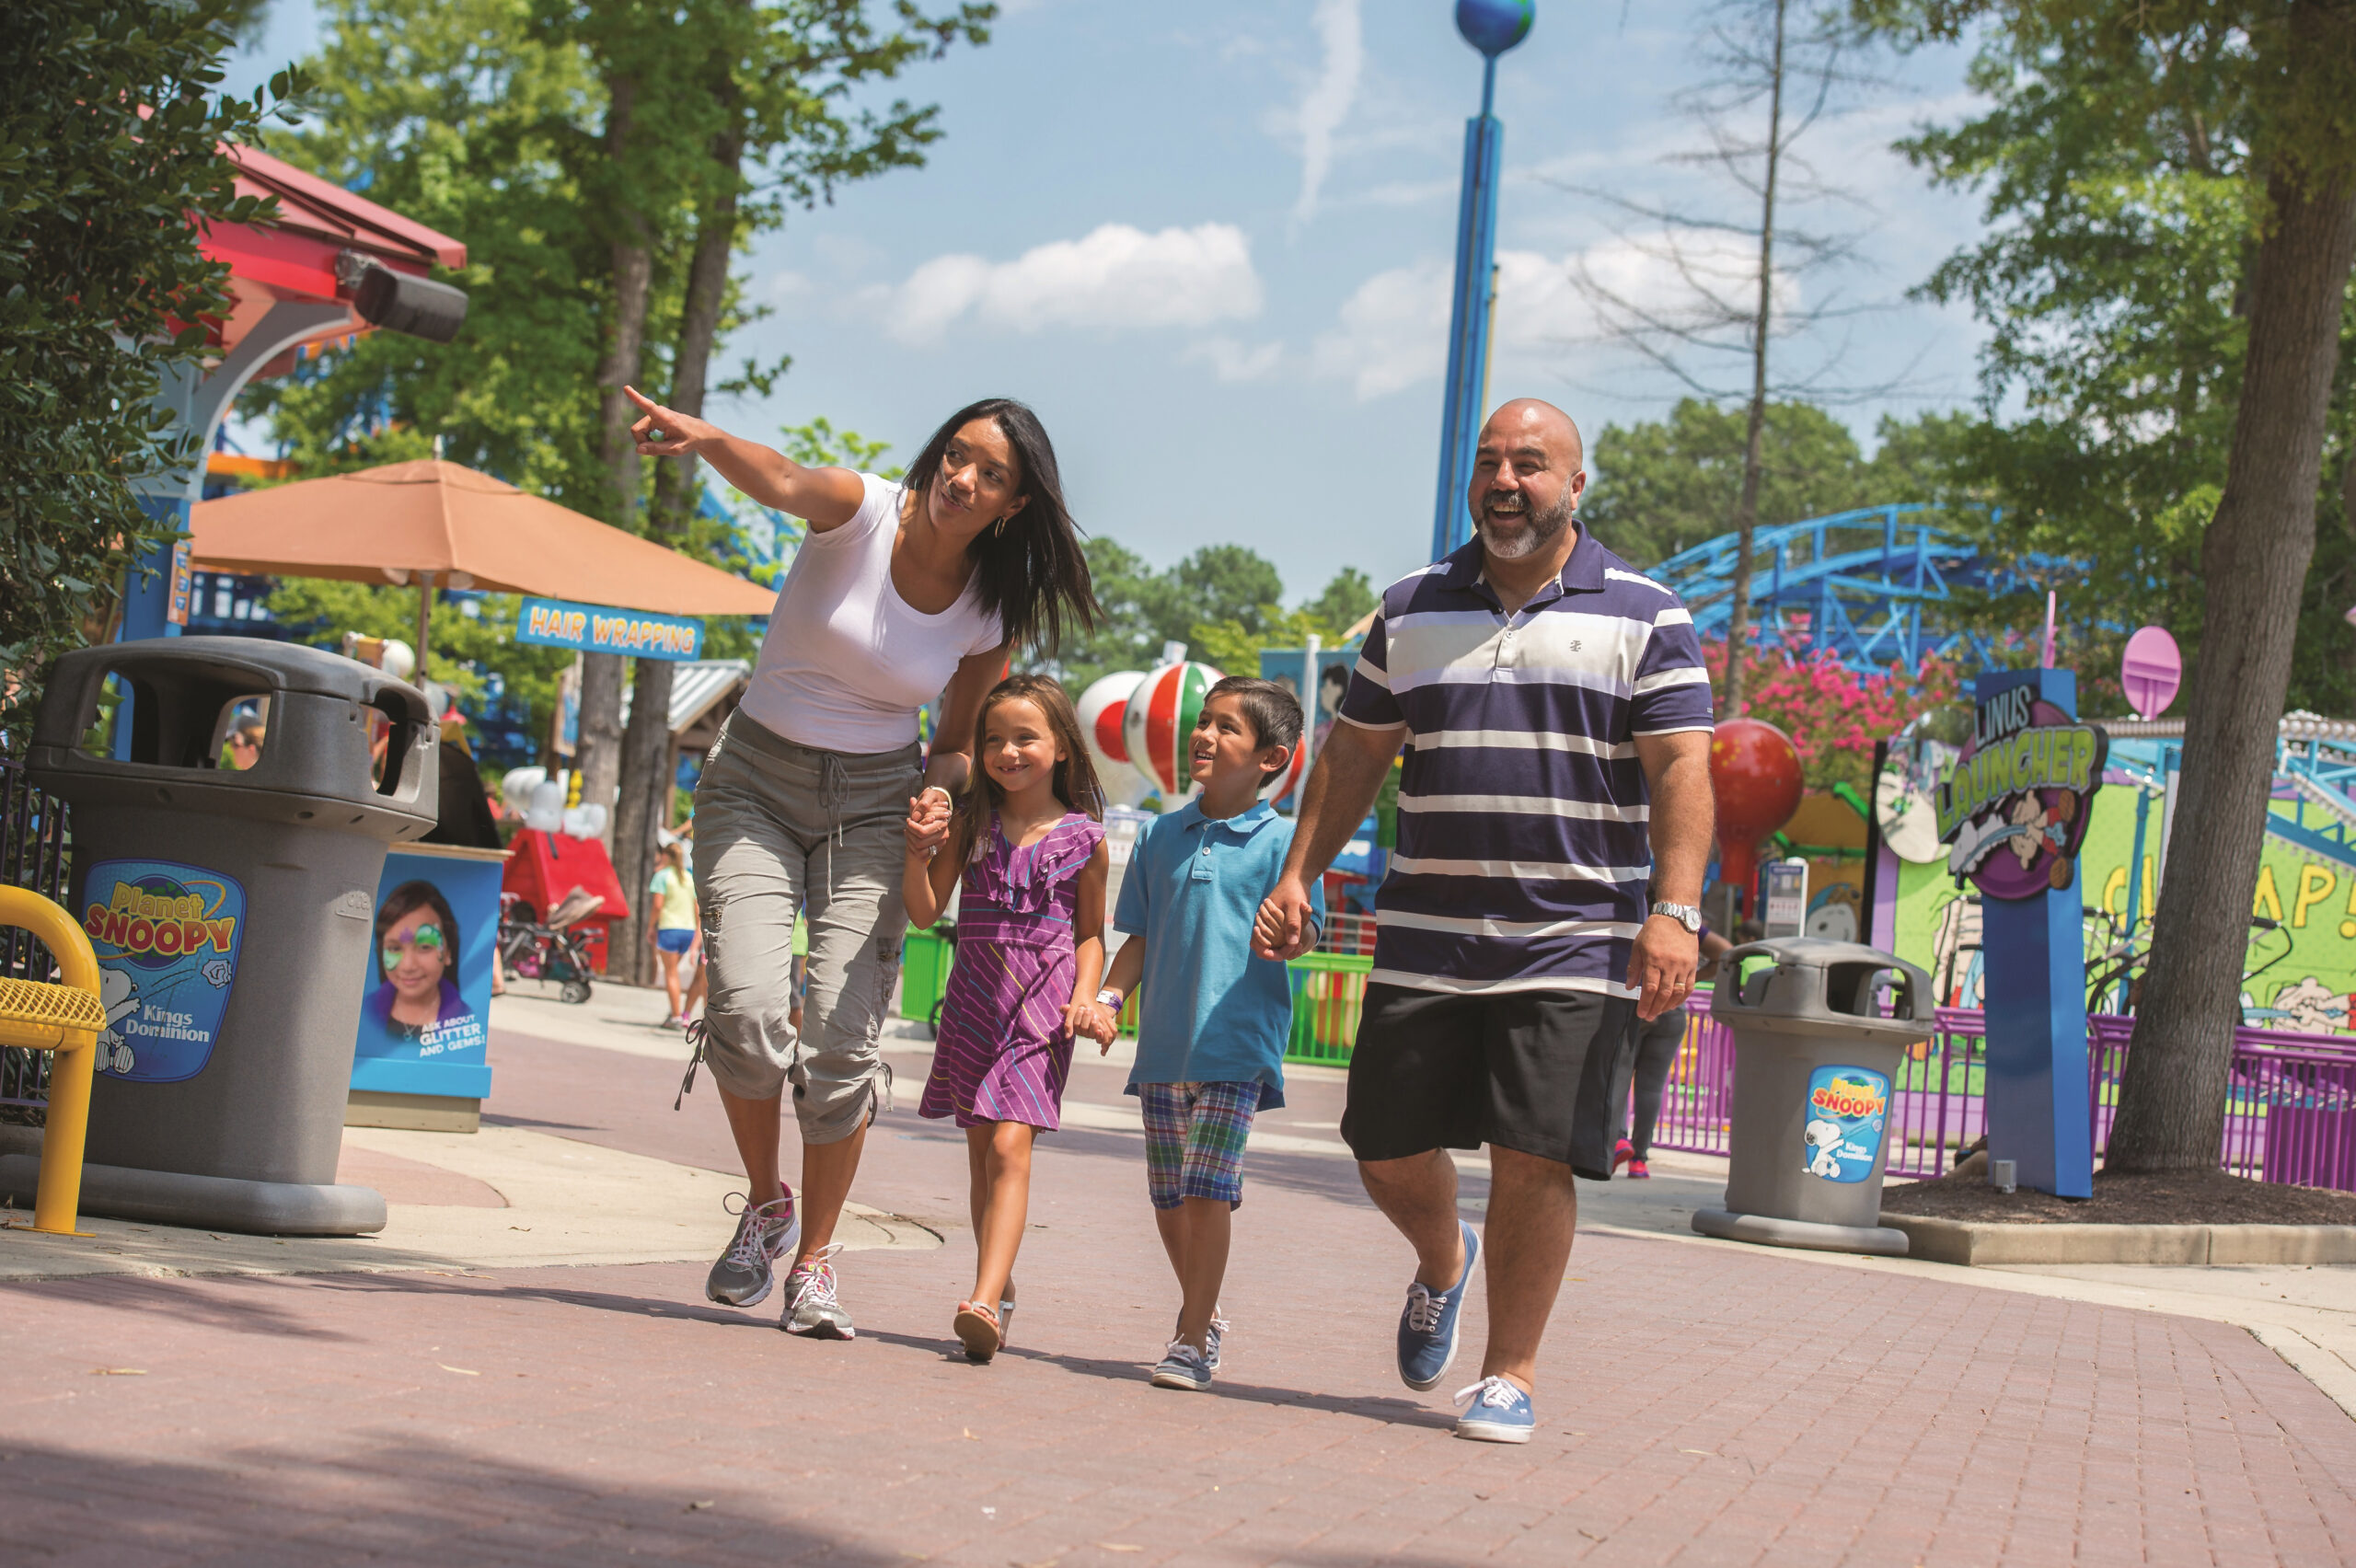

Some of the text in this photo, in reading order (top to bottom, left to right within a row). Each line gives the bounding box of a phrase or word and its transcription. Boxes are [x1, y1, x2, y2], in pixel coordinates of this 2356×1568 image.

[528, 605, 696, 654] HAIR WRAPPING
[1974, 685, 2031, 748] LINUS
[1934, 725, 2096, 844] LAUNCHER
[111, 881, 205, 920] Planet
[84, 903, 236, 955] SNOOPY
[125, 1019, 210, 1043] Dominion
[144, 1004, 193, 1029] Kings
[422, 1015, 476, 1033] ASK ABOUT
[419, 1022, 481, 1046] GLITTER
[420, 1035, 486, 1057] AND GEMS!
[1811, 1088, 1886, 1117] SNOOPY
